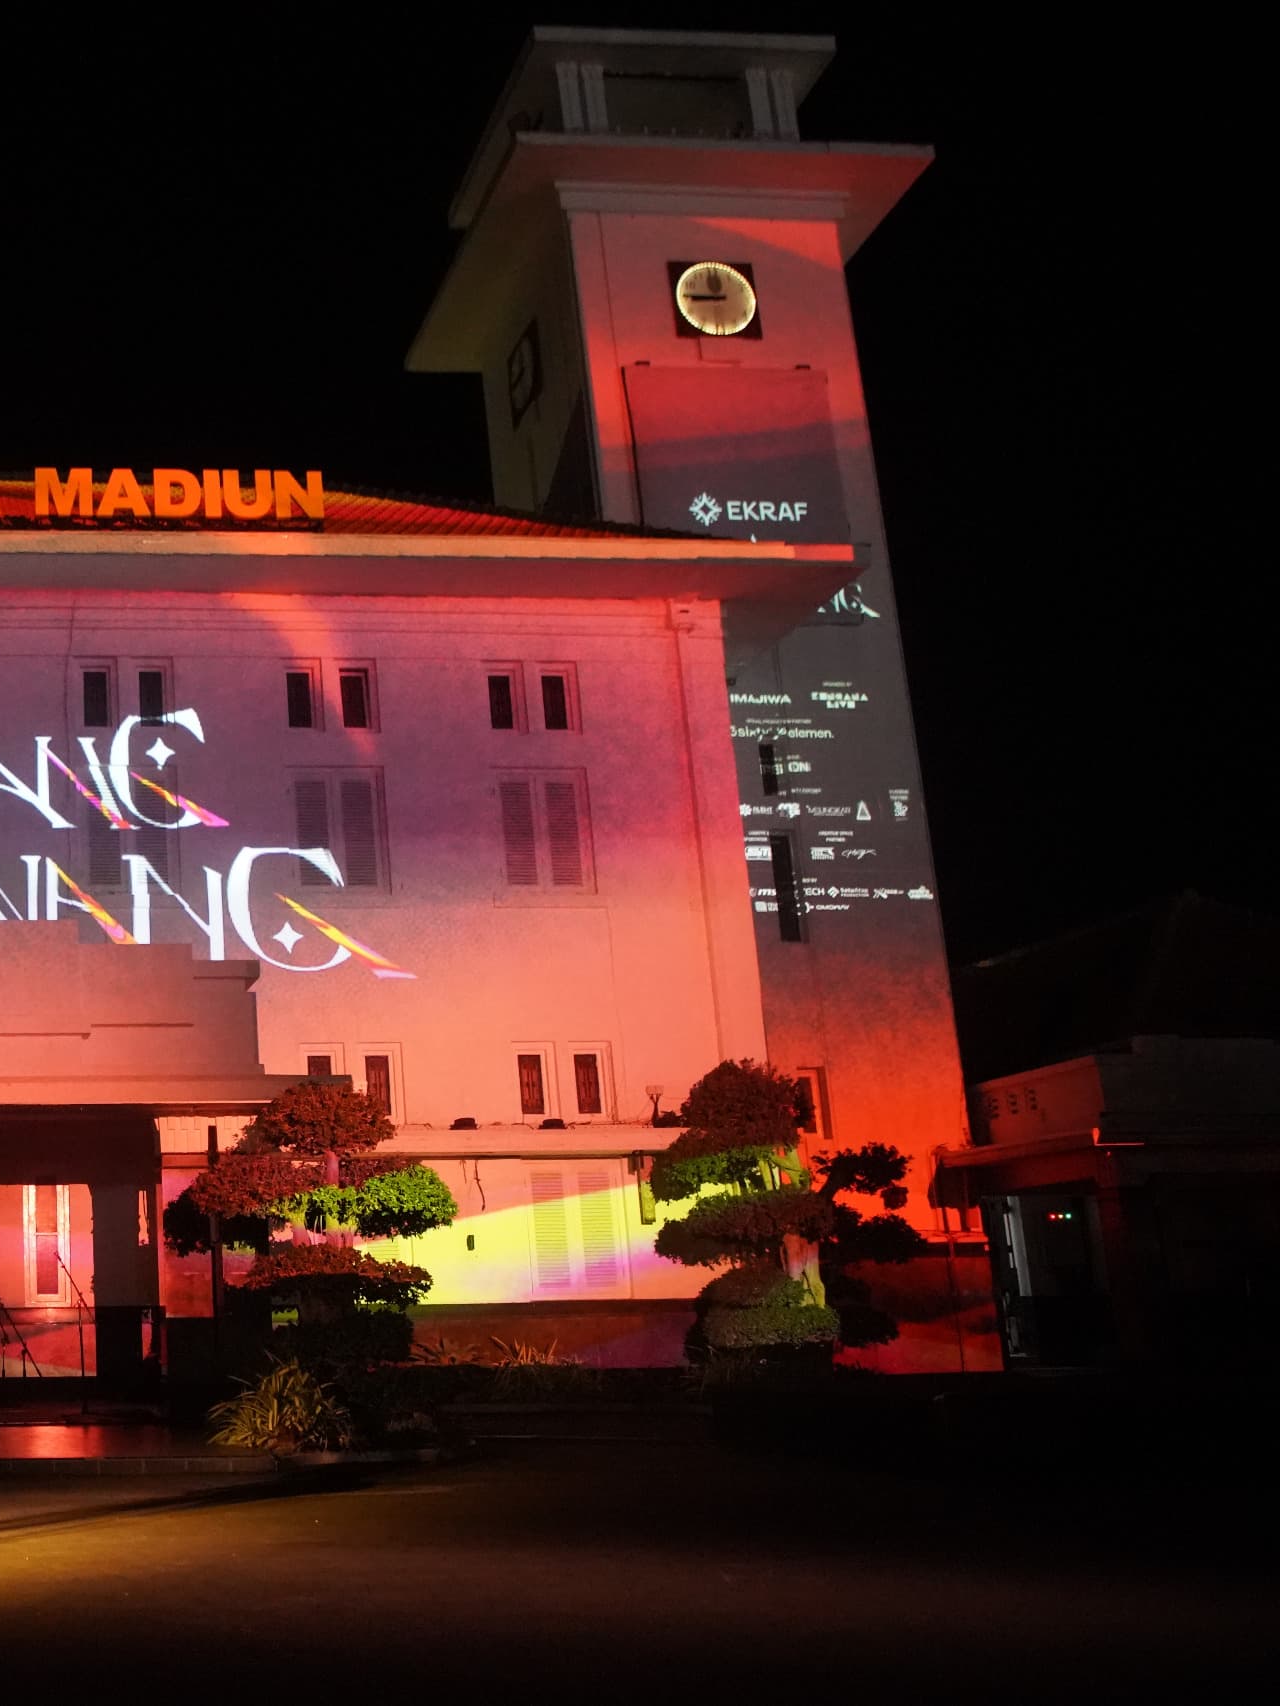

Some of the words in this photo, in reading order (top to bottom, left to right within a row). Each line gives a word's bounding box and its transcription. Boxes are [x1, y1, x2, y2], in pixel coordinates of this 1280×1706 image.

[34, 468, 323, 519] MADIUN
[727, 501, 807, 521] EKRAF
[730, 694, 792, 704] IMAJIWA
